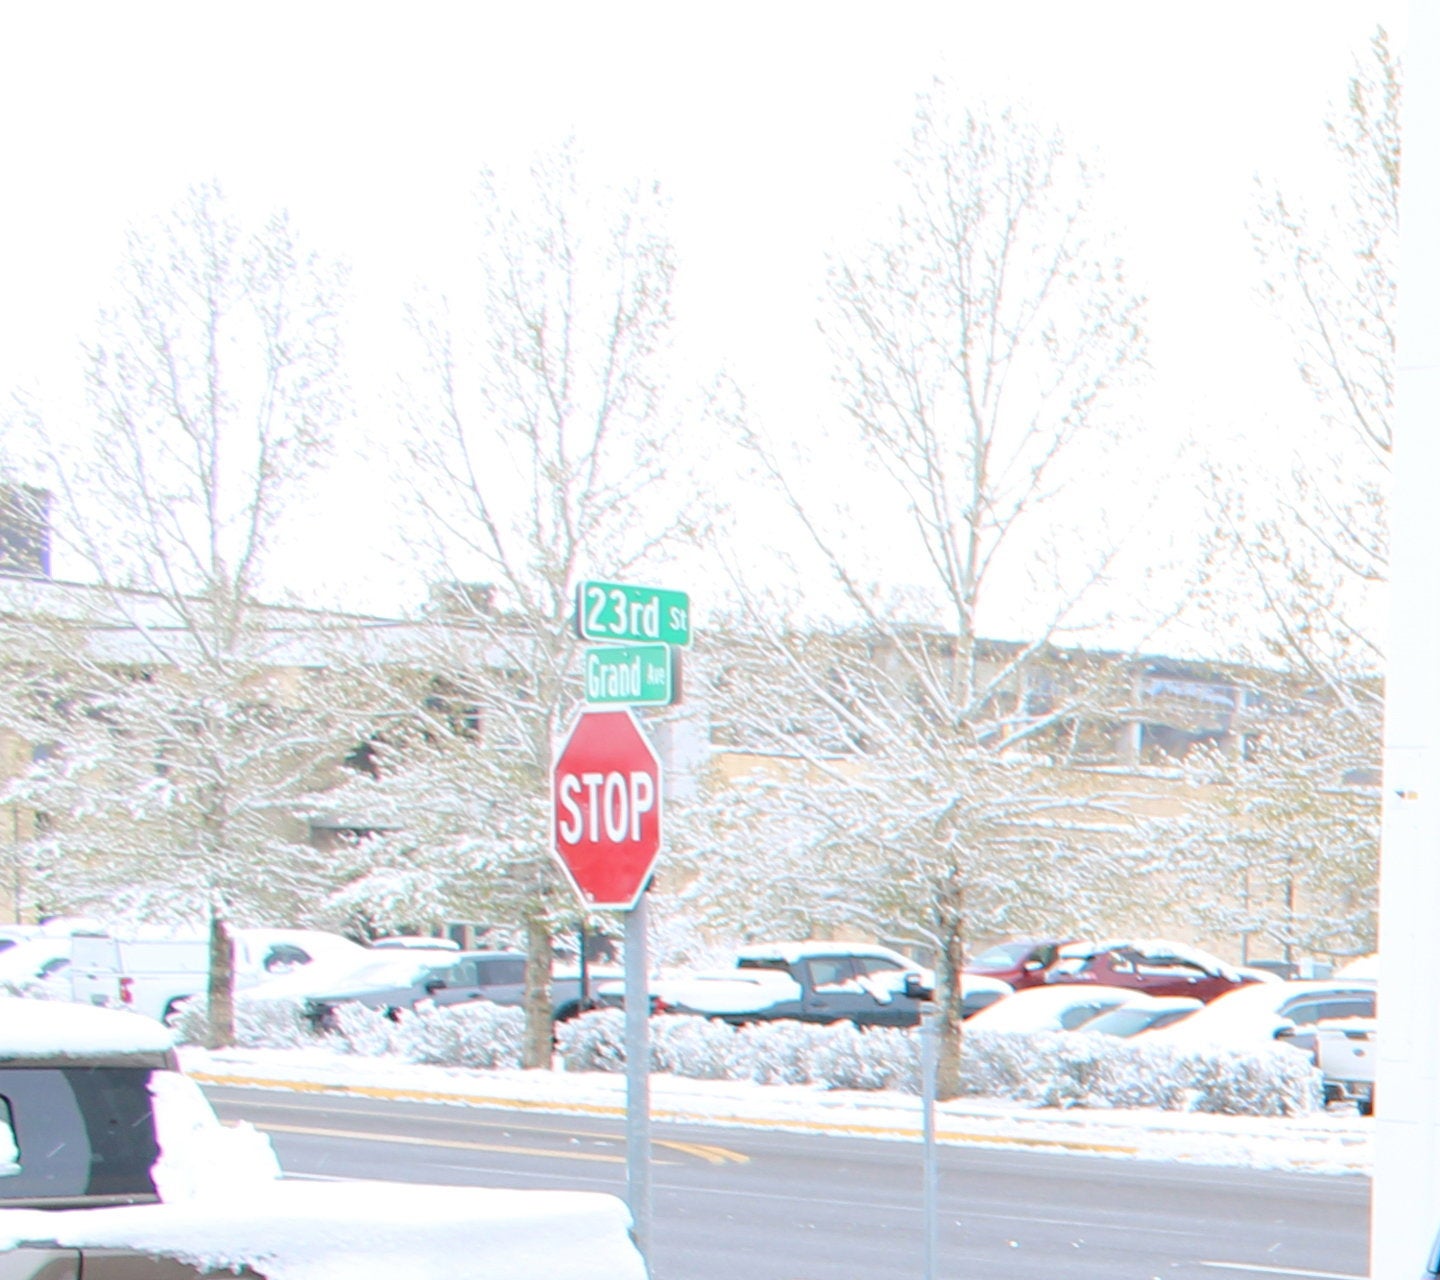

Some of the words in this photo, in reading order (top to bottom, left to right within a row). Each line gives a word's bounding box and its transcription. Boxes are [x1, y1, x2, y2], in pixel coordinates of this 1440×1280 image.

[587, 586, 660, 638] 23rd
[669, 605, 688, 632] St
[588, 654, 641, 698] Grand
[647, 662, 665, 685] Ave
[559, 770, 654, 845] STOP
